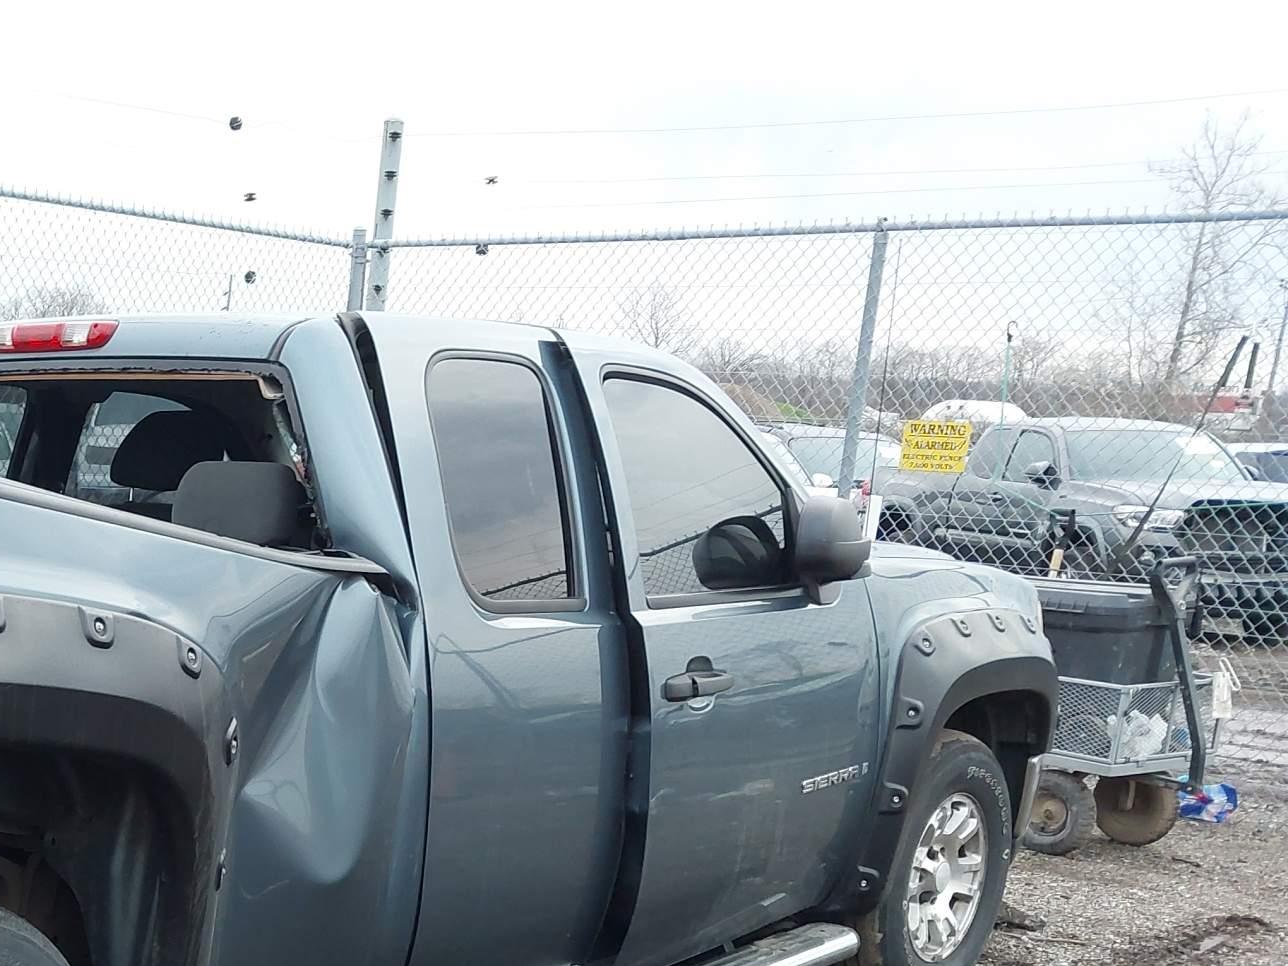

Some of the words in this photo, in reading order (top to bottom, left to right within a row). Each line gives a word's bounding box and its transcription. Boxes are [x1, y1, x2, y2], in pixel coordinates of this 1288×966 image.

[910, 423, 967, 436] WARNING
[912, 440, 957, 451] ALARMED
[801, 764, 860, 795] SIERRA
